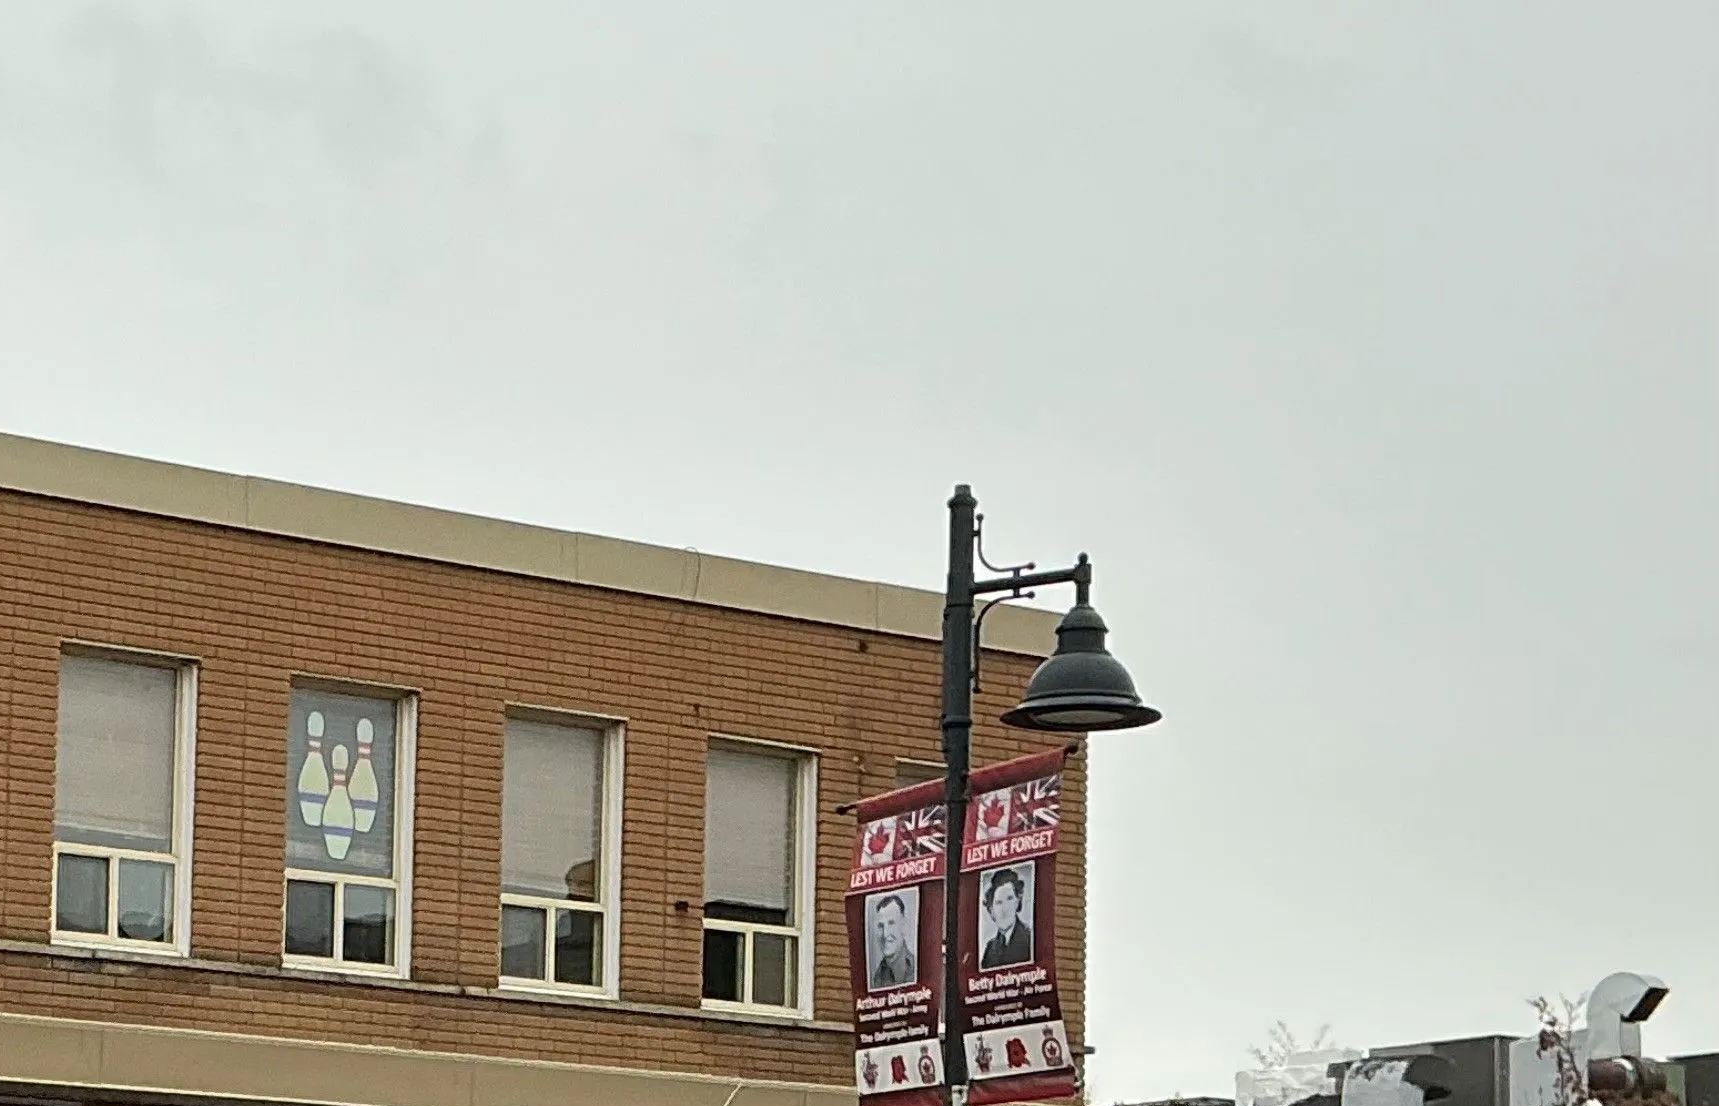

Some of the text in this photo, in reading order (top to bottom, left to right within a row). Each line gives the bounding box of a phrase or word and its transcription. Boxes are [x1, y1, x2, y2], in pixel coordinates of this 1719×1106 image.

[967, 829, 1054, 865] LEST WE FORGET
[850, 857, 937, 889] LEST WE FORGET
